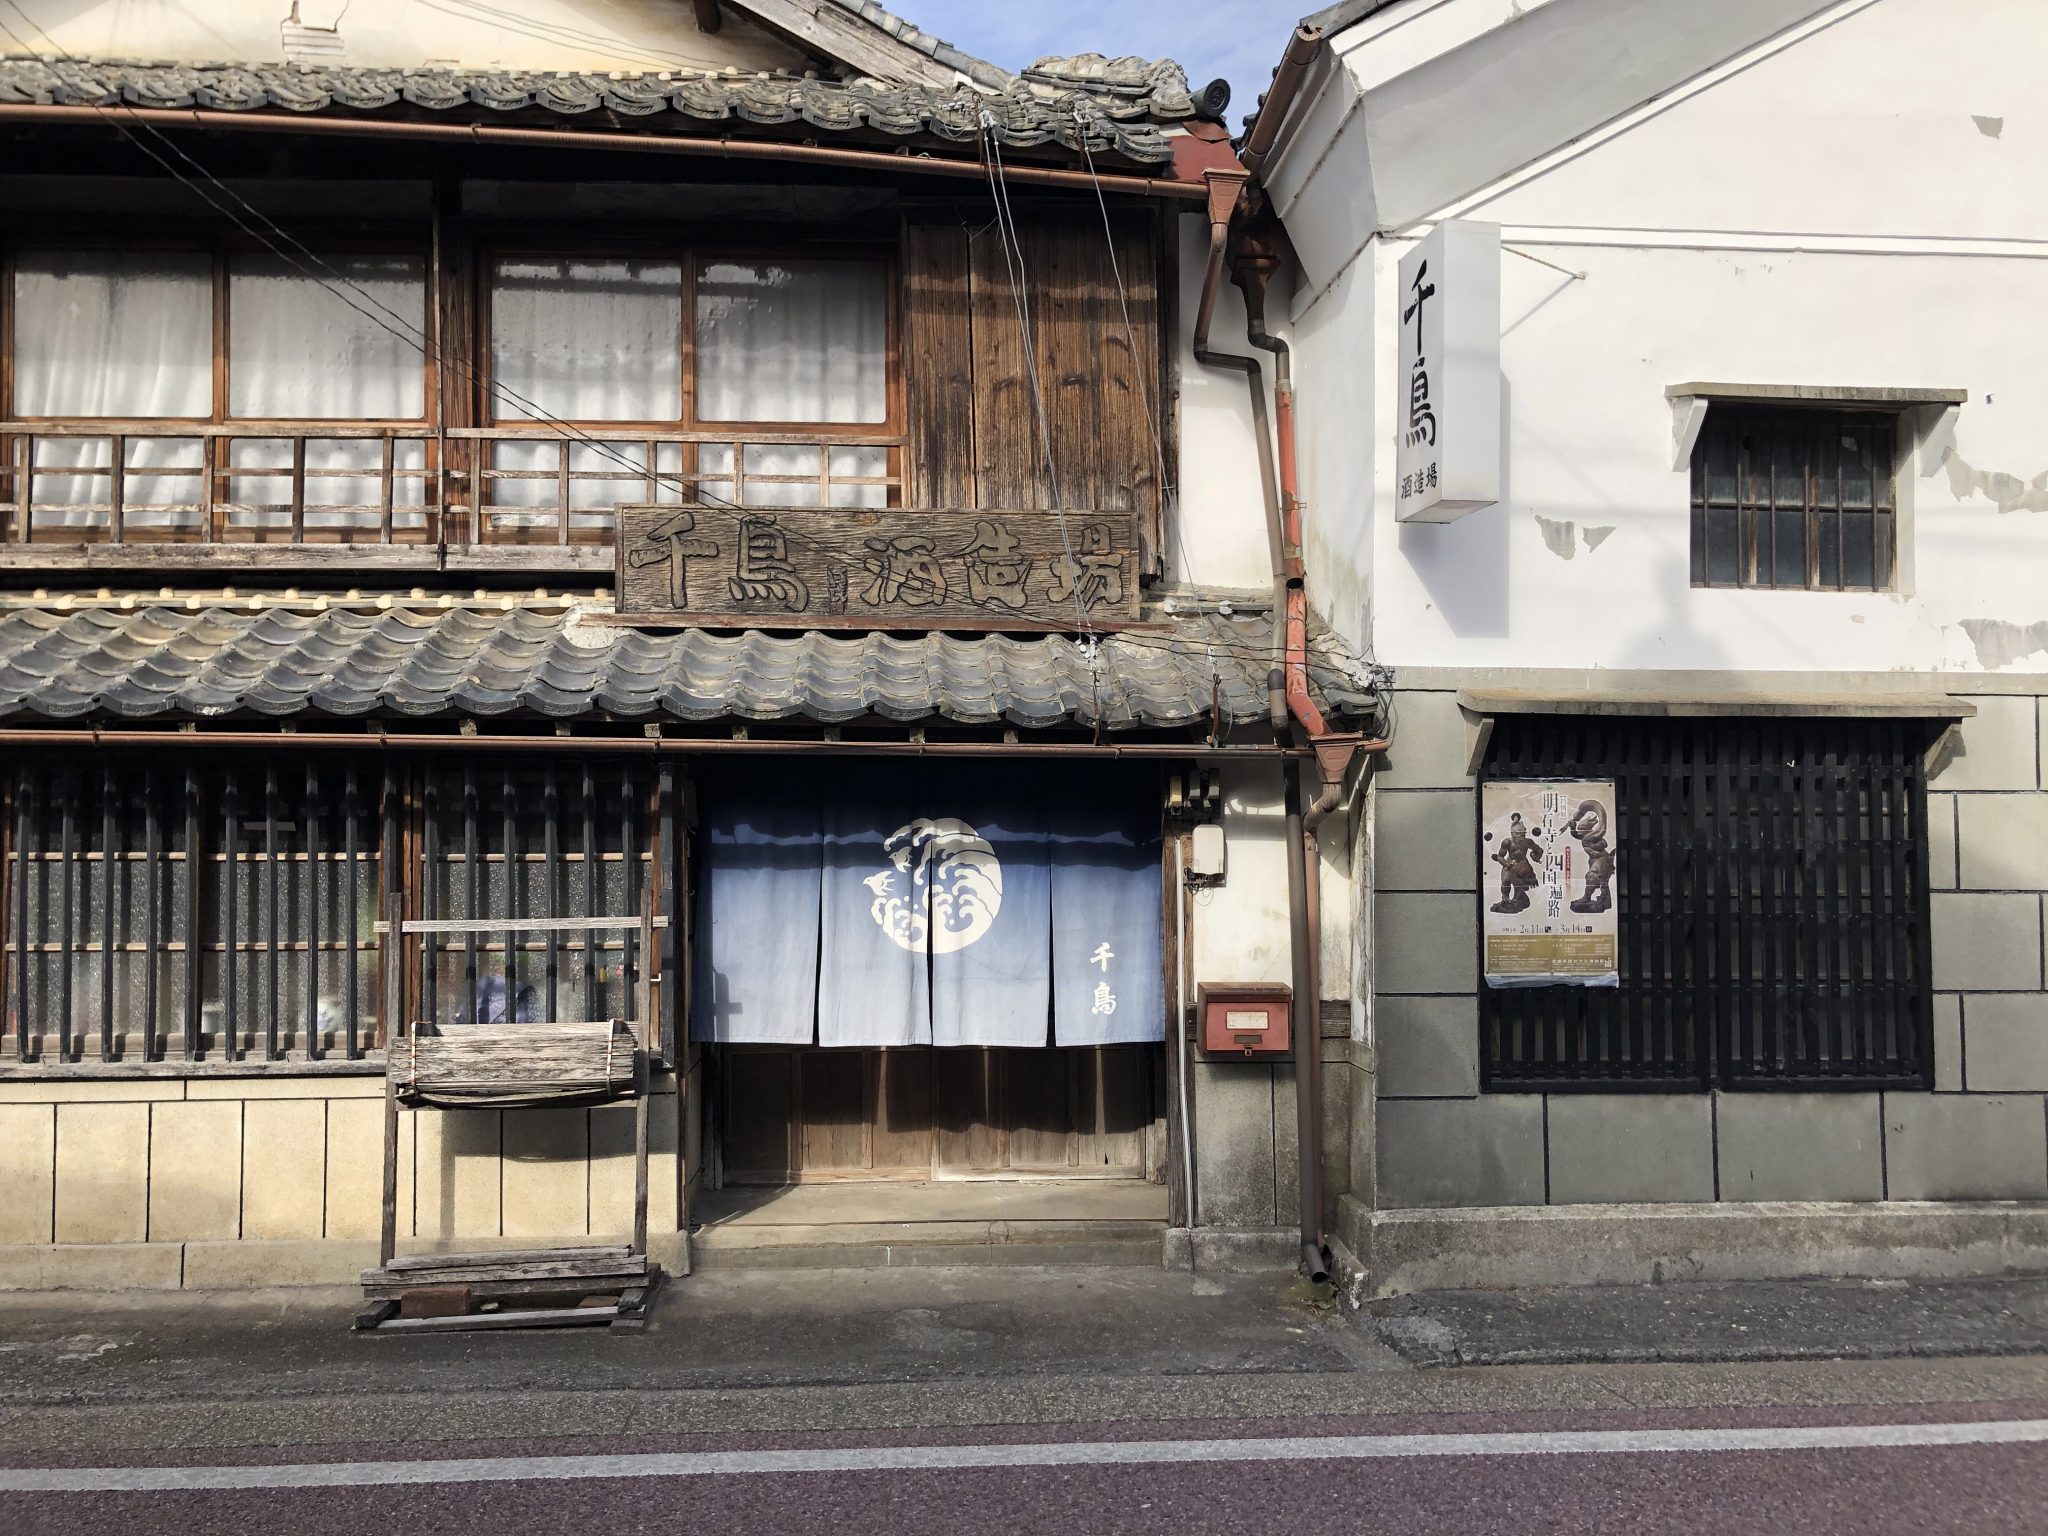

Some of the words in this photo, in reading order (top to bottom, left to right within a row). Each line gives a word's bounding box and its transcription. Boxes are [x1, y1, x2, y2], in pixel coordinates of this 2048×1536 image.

[1403, 258, 1437, 449] 千鳥
[1400, 461, 1438, 500] 酒造場
[1089, 941, 1117, 1015] 千鳥
